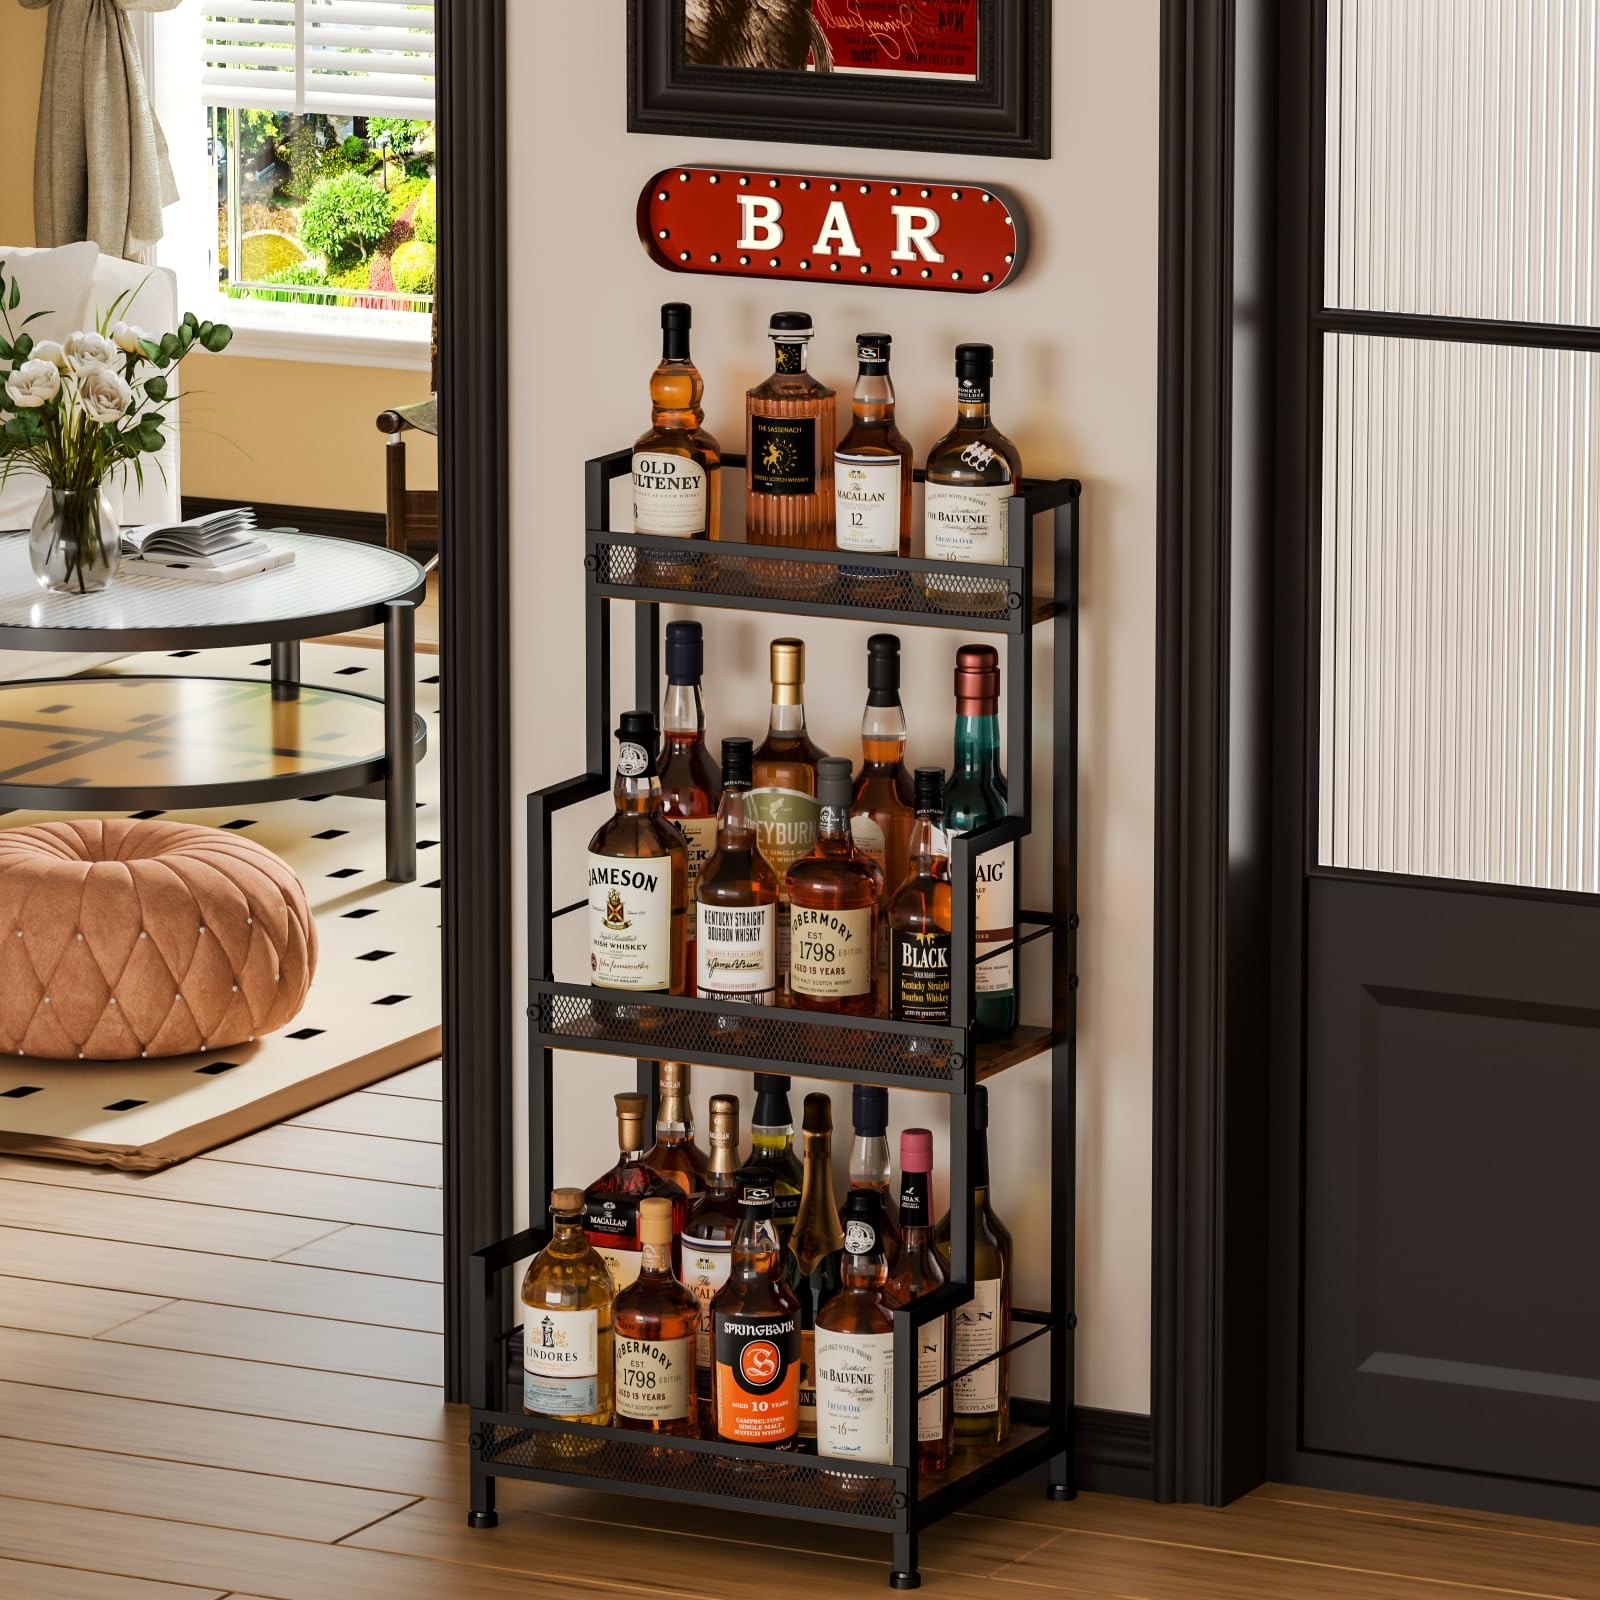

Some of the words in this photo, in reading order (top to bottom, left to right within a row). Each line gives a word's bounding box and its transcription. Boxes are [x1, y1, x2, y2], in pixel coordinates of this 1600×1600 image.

[737, 195, 944, 263] BAR
[640, 460, 676, 475] OLD
[632, 472, 701, 490] ULTENEY
[837, 489, 885, 502] MACALLAN
[851, 512, 863, 526] 12
[938, 511, 988, 524] BALVENIE
[946, 551, 957, 561] 16
[588, 867, 658, 893] JAMESON
[704, 910, 734, 927] KENTUCKY
[734, 910, 765, 927] STRAIGHT
[707, 926, 733, 942] BOURBON
[735, 927, 761, 942] WHISKEY
[610, 943, 648, 951] WHISKEY
[799, 941, 835, 962] 1798
[902, 942, 949, 969] BLACK
[794, 962, 807, 973] AGED
[809, 966, 817, 975] 15
[819, 967, 846, 976] YEARS
[902, 979, 926, 993] Kentucky
[927, 980, 950, 993] Straight
[902, 991, 924, 1003] Bourbon
[926, 992, 949, 1004] Whiskey
[590, 1215, 628, 1228] MACALLAN
[526, 1346, 578, 1362] LINDORES
[623, 1368, 656, 1389] 1798
[819, 1369, 828, 1380] THE
[829, 1368, 874, 1385] BALVENIE
[632, 1392, 639, 1400] 15
[641, 1393, 666, 1401] YEARS
[732, 1401, 748, 1409] AGED
[751, 1401, 769, 1412] 10
[771, 1400, 789, 1409] YEARS
[827, 1400, 847, 1412] FRENCH
[848, 1404, 862, 1413] OAK
[957, 1403, 996, 1412] SCOTLAND
[735, 1415, 785, 1425] CAMPBELTOWN
[738, 1423, 763, 1431] SINGLE
[764, 1422, 782, 1430] MALT
[734, 1428, 761, 1437] SCOTCH
[838, 1422, 847, 1436] 16
